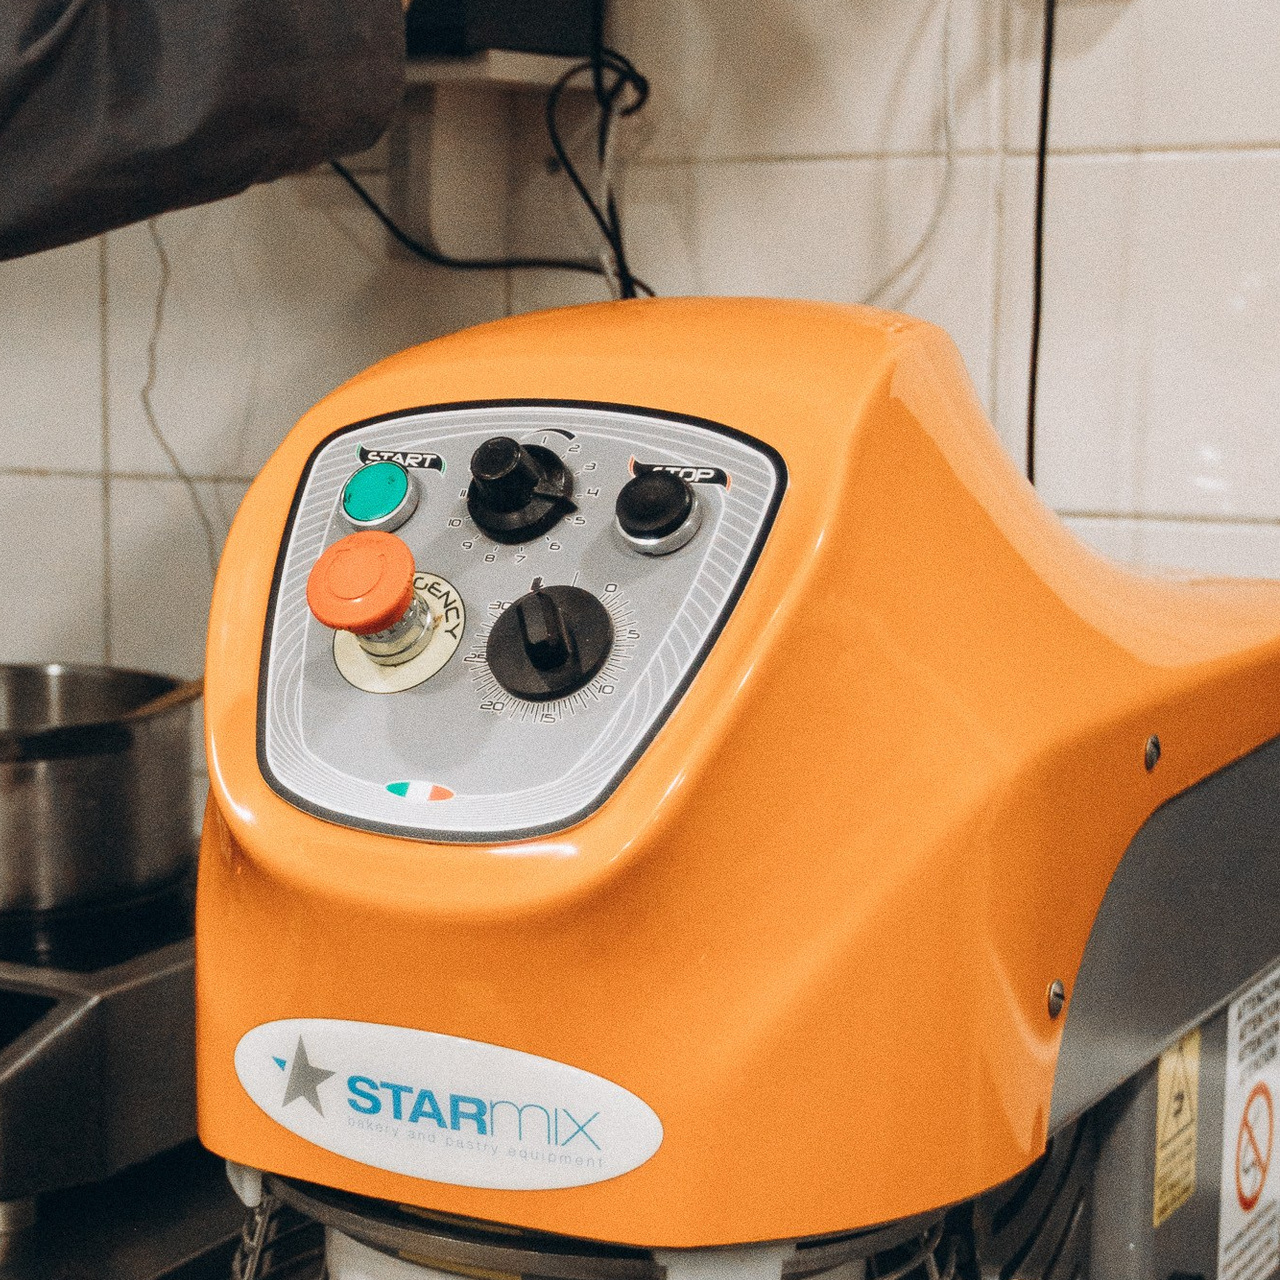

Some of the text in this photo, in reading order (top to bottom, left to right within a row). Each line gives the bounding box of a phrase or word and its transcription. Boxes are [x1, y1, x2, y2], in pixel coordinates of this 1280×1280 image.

[568, 444, 580, 453] 2
[366, 451, 437, 468] START
[584, 462, 596, 471] 3
[653, 466, 715, 482] TOP
[587, 488, 599, 496] 4
[448, 519, 461, 527] 10
[574, 517, 586, 525] 5
[462, 542, 473, 550] 9
[549, 543, 561, 551] 6
[484, 553, 495, 563] 8
[515, 554, 526, 564] 7
[605, 583, 617, 592] 0
[413, 576, 460, 640] GENCY
[628, 630, 640, 639] 5
[598, 684, 615, 695] 10
[480, 700, 505, 711] 20
[540, 713, 555, 724] 15
[408, 1130, 436, 1144] and
[445, 1136, 498, 1156] pastry
[508, 1147, 604, 1168] equipment
